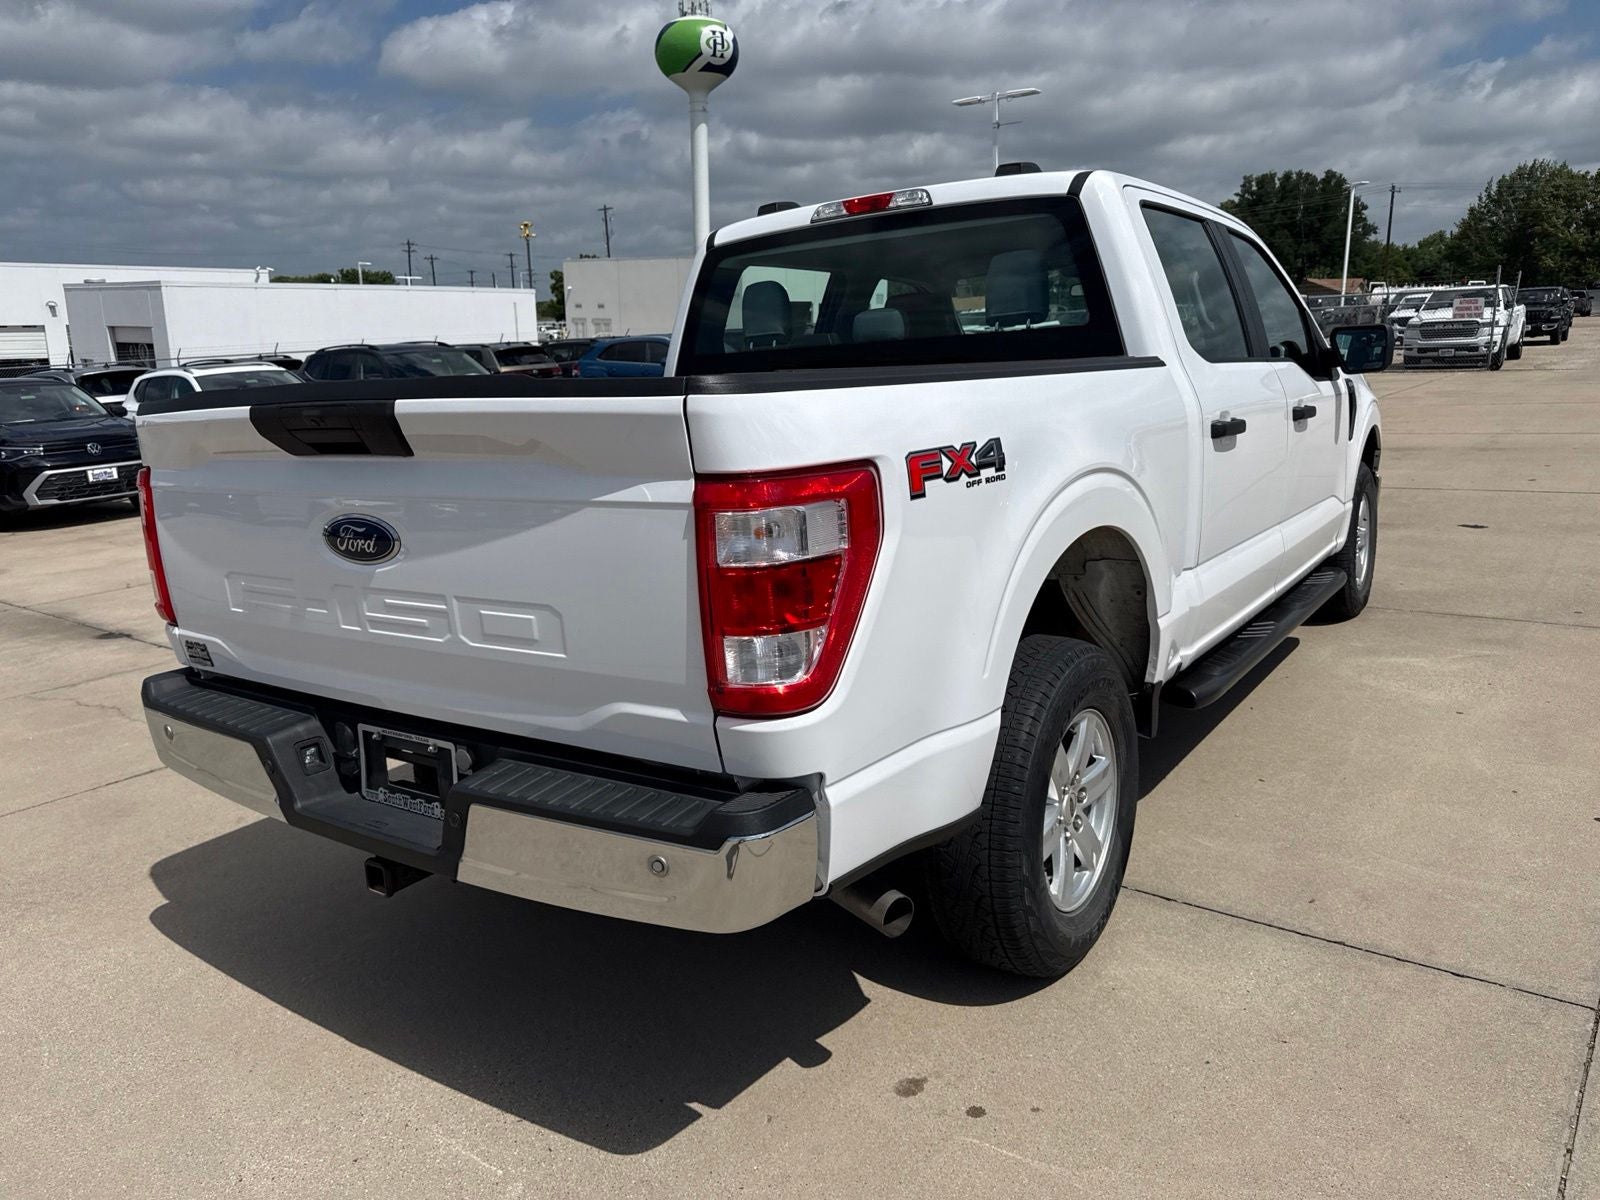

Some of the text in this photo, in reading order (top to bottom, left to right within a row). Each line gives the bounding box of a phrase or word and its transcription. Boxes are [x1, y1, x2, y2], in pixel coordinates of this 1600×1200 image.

[905, 437, 1006, 501] FX4
[965, 473, 1006, 489] OFF ROAD
[336, 524, 378, 553] Ford
[224, 571, 567, 658] F-150
